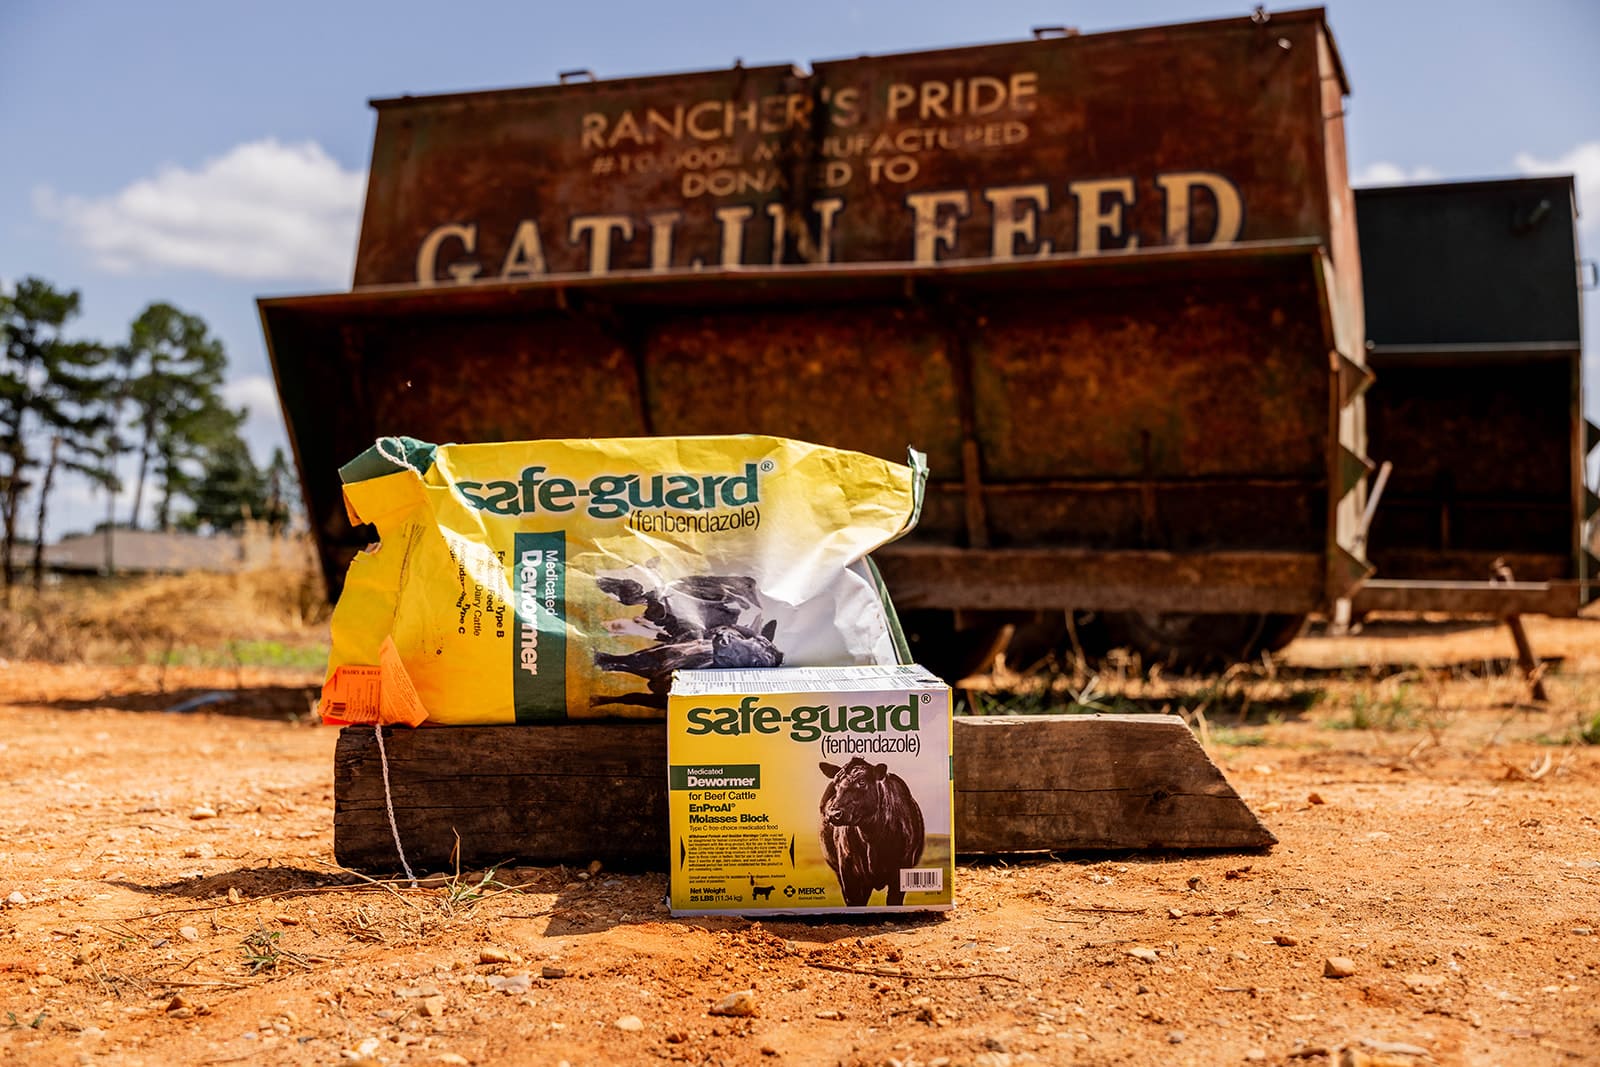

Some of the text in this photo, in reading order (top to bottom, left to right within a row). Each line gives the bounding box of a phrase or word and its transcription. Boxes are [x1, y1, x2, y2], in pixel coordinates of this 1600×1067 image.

[580, 72, 1039, 149] RANCHER'S PRIDE
[868, 155, 918, 184] TO
[416, 171, 1243, 287] GATLIN FEED
[629, 505, 760, 533] (fenbendazole)
[545, 550, 559, 616] Medicated
[472, 584, 482, 608] Dairy
[473, 610, 482, 636] Cattle
[495, 605, 505, 629] Type
[521, 549, 542, 676] Dewormer
[458, 627, 466, 635] C
[820, 734, 921, 758] (fenbendazole)
[687, 776, 756, 787] Dewormer
[689, 791, 757, 801] for Beef Cattle
[689, 814, 770, 824] Molasses Block
[703, 887, 726, 895] Weight
[798, 887, 825, 895] MERCK
